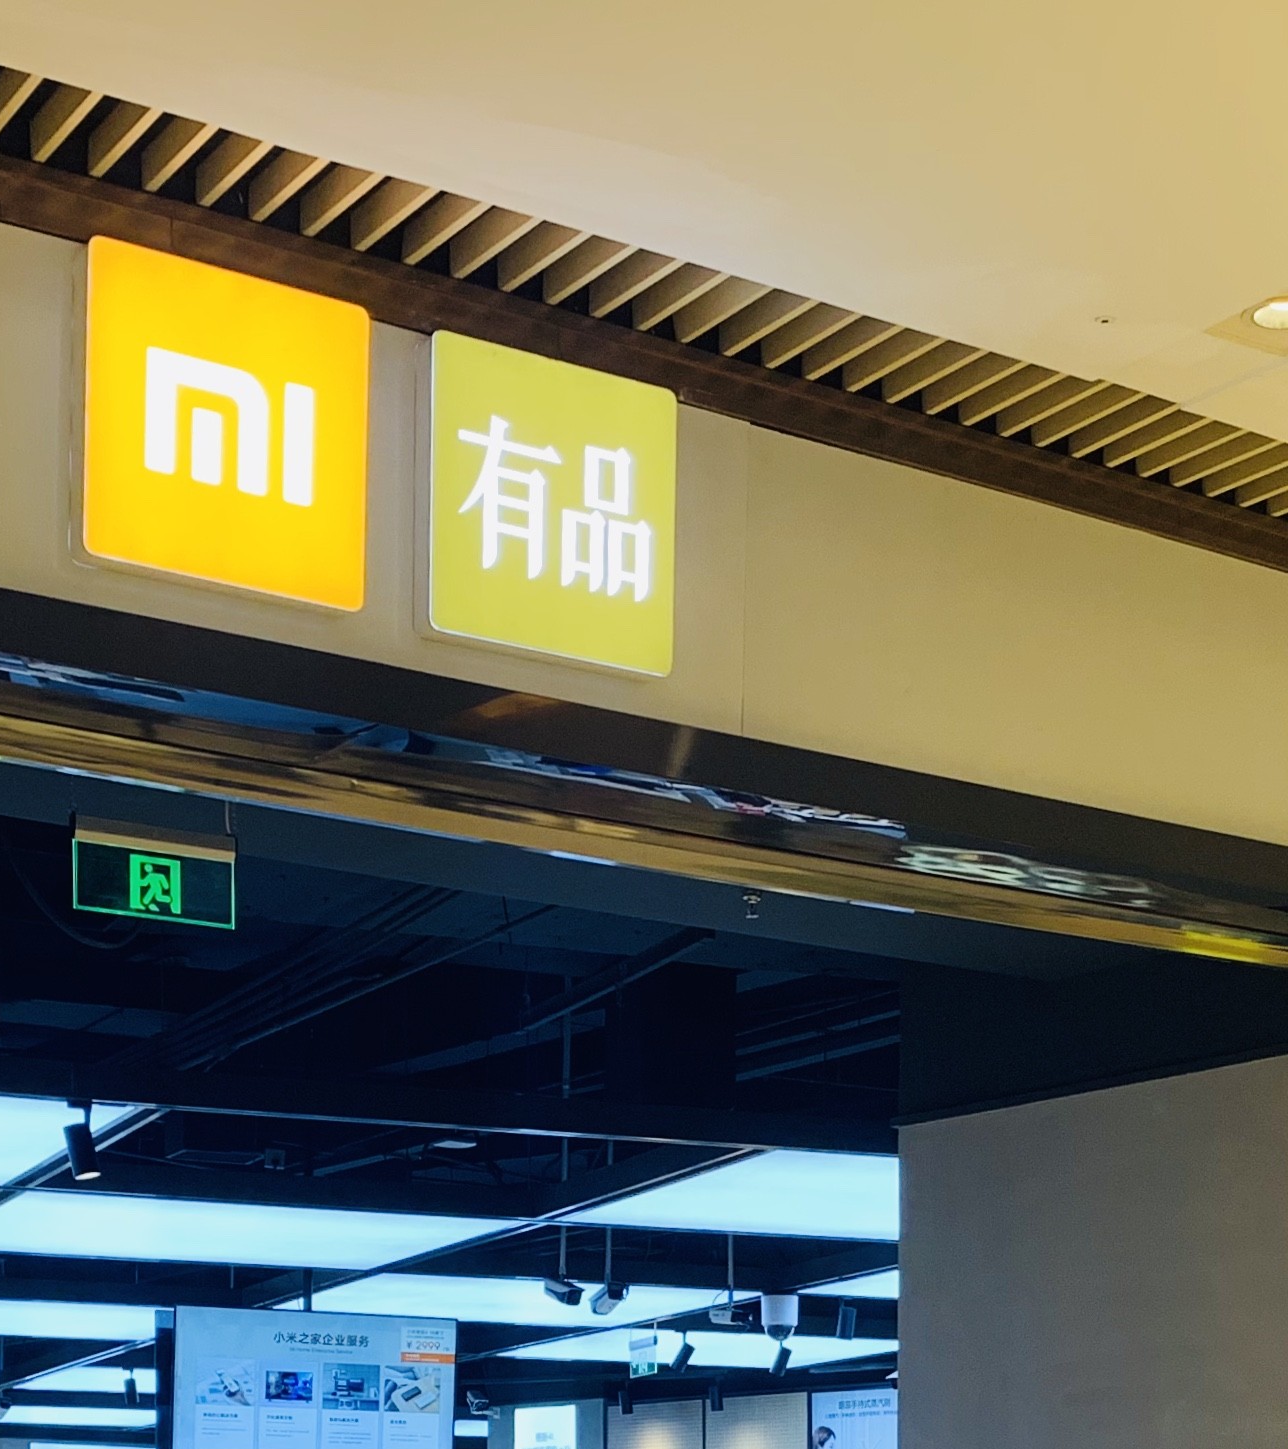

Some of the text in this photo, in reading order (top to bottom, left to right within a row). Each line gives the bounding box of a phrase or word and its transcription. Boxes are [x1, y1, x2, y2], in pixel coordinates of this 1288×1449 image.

[457, 414, 652, 602] 有品
[273, 1331, 369, 1348] 小米之家企业服务
